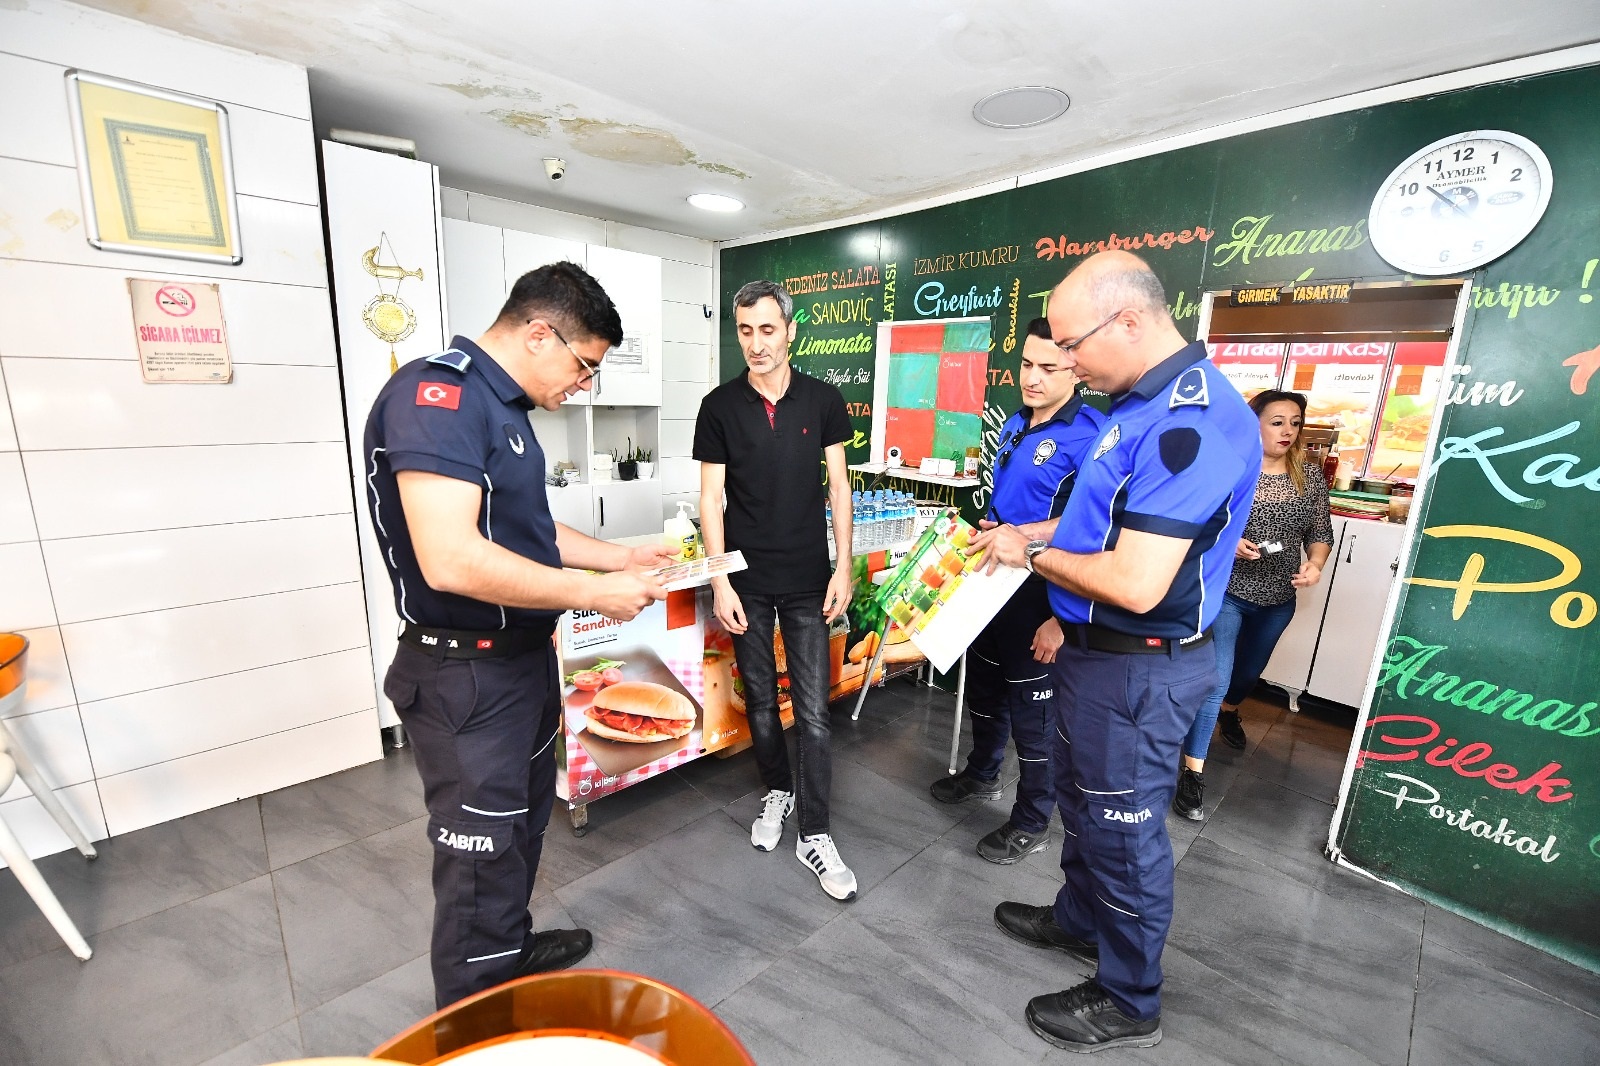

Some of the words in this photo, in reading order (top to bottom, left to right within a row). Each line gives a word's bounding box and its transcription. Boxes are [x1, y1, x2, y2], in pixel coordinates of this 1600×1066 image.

[1453, 147, 1475, 162] 12
[1491, 151, 1499, 164] 1
[1424, 160, 1443, 174] 11
[1436, 165, 1486, 181] AYMER
[1510, 168, 1523, 182] 2
[1399, 182, 1419, 197] 10
[1035, 225, 1215, 261] Hamburger
[1212, 214, 1368, 266] Ananas
[913, 253, 956, 276] İZMİR
[959, 245, 1020, 269] KUMRU
[831, 265, 881, 290] SALATA
[1293, 283, 1351, 301] YASAKTIR
[140, 323, 180, 342] SİGARA
[181, 325, 222, 345] İÇİLMEZ
[796, 332, 873, 356] Limonata
[854, 367, 871, 385] Süt
[1375, 635, 1600, 737] Ananas
[1103, 807, 1153, 824] ZABITA
[1375, 772, 1561, 863] Portakal
[437, 827, 495, 853] ZABITA
